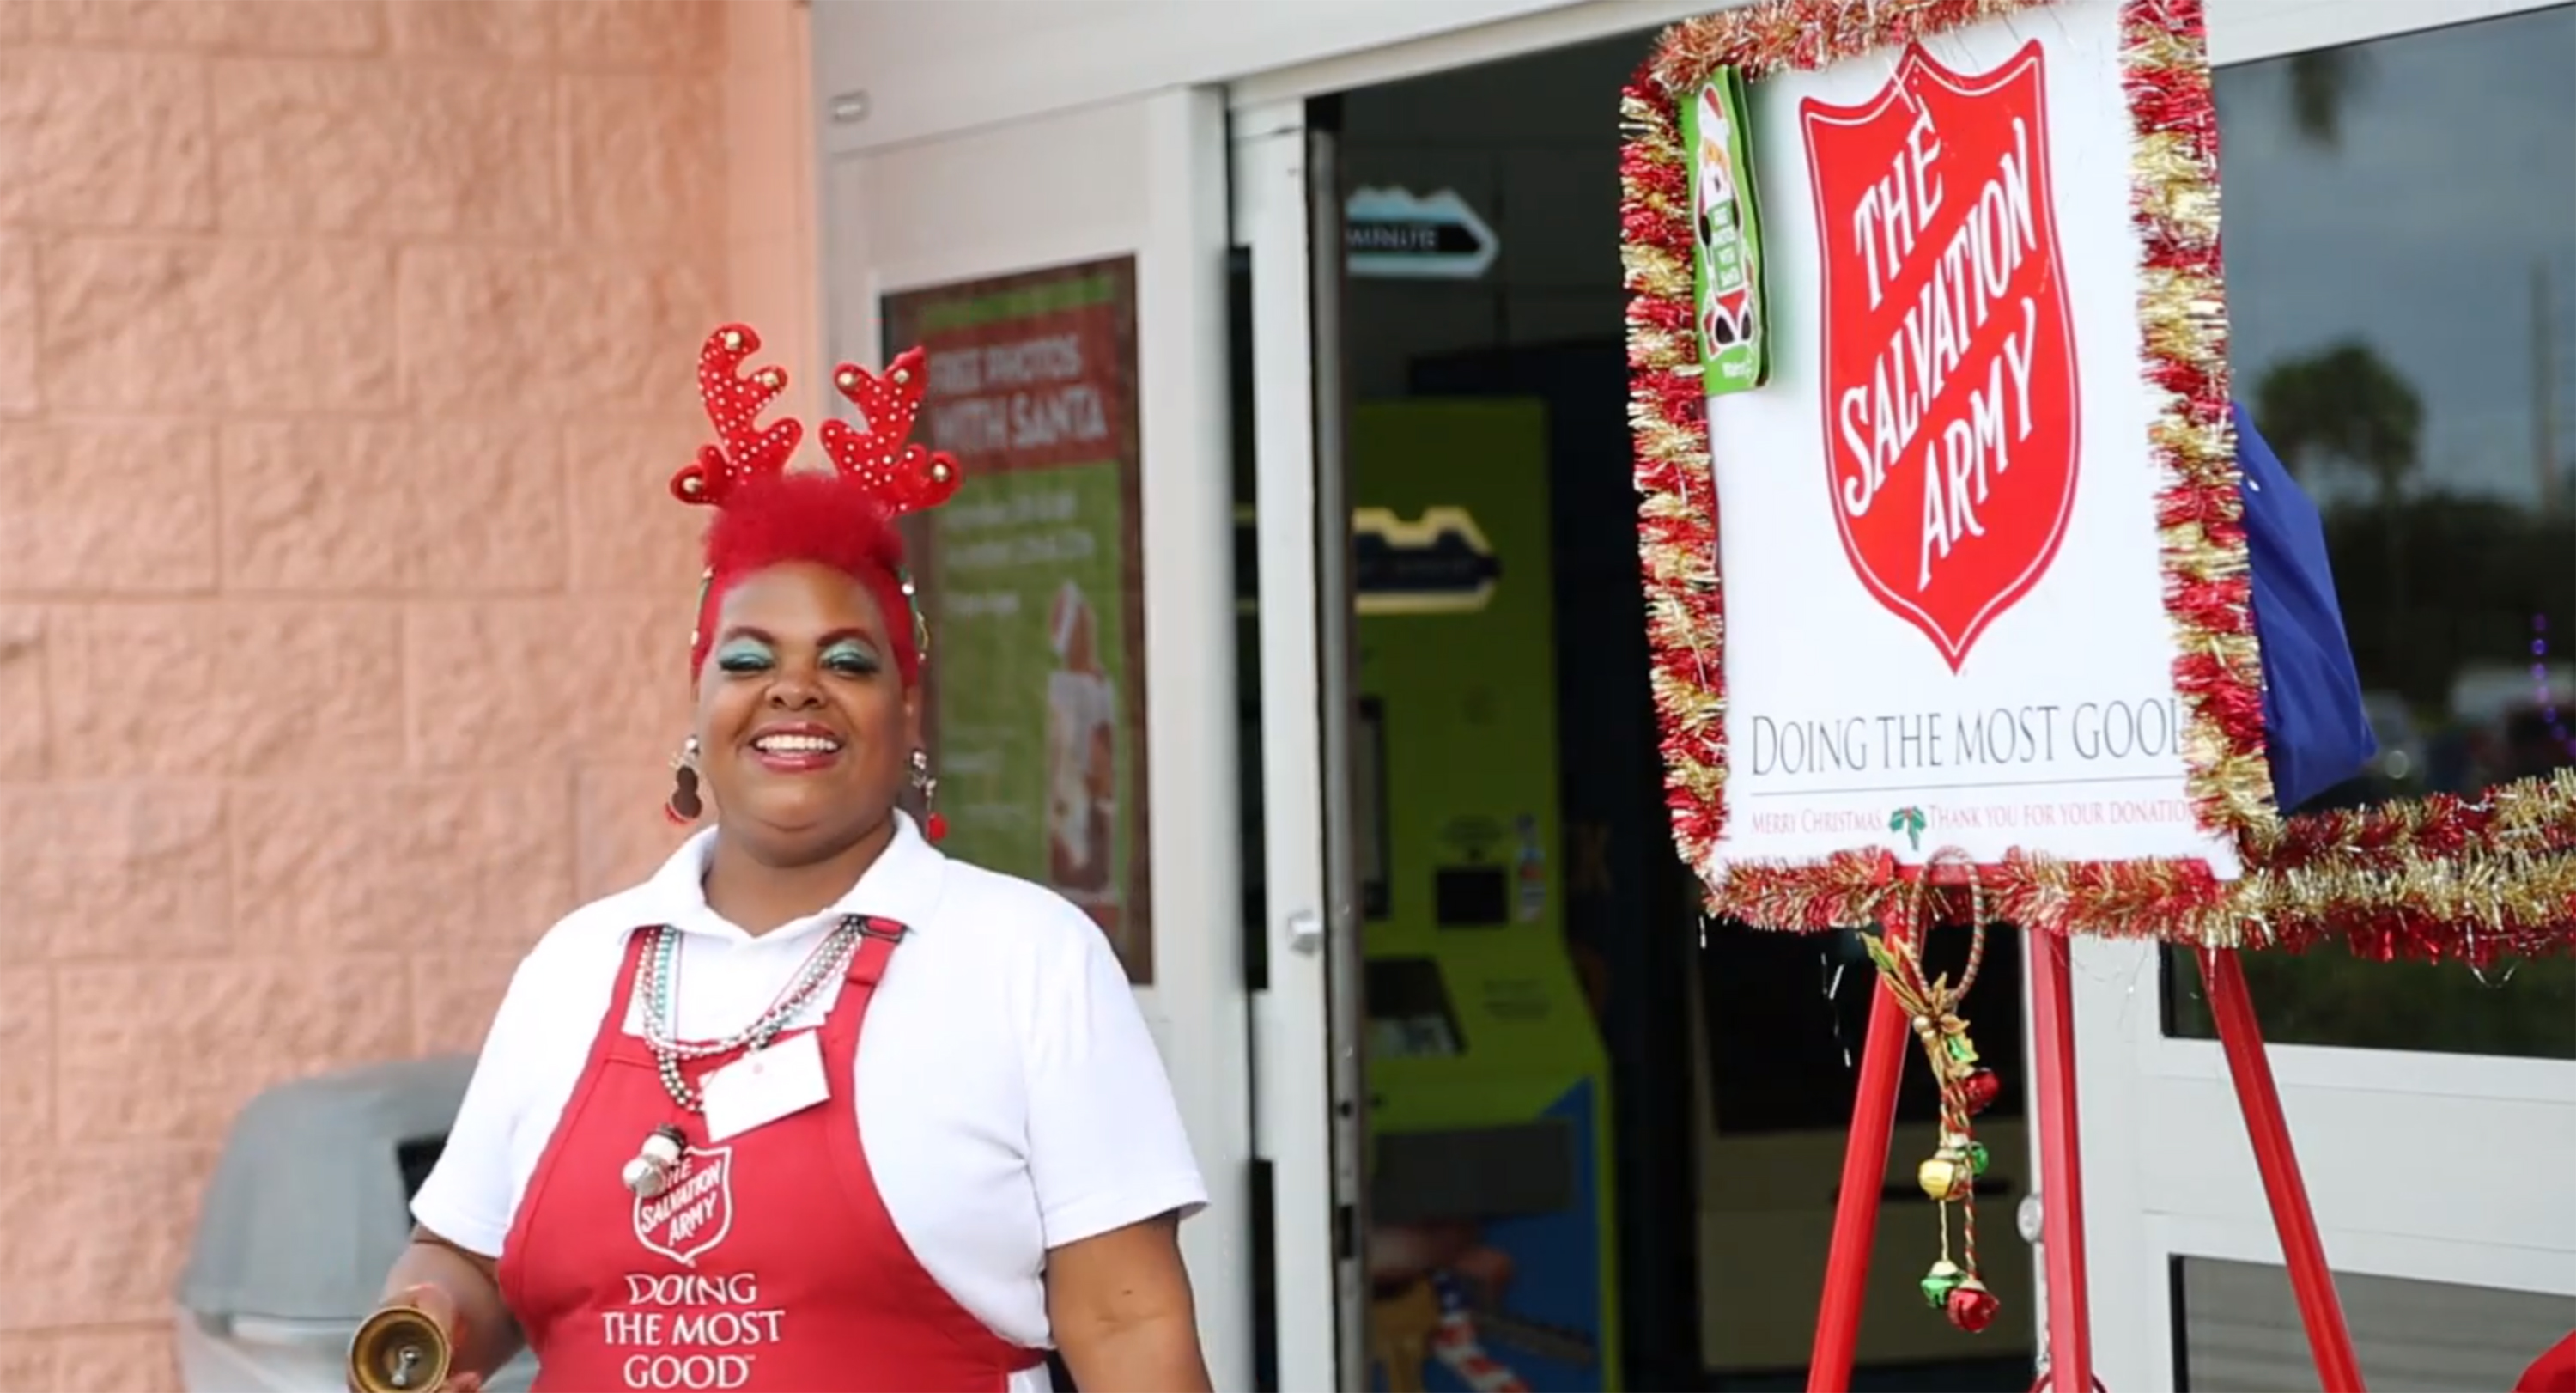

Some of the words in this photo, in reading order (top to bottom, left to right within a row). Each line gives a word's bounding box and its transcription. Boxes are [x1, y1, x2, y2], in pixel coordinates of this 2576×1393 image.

[1853, 112, 1943, 312] THE
[1840, 117, 2037, 517] SALVATION
[984, 335, 1081, 380] PHOTOS
[1012, 383, 1109, 447] SANTA
[1918, 297, 2036, 592] ARMY
[1752, 715, 1868, 776] DOING
[1876, 713, 1943, 769] THE
[1955, 706, 2059, 765] MOST
[1751, 811, 1796, 834] MERRY
[1801, 808, 1883, 834] CHRISTMAS
[1928, 804, 1981, 829] THANK
[1986, 806, 2019, 828] YOU
[2025, 804, 2057, 826] FOR
[2059, 802, 2105, 826] YOUR
[641, 1159, 722, 1234] SALVATION
[666, 1158, 693, 1188] HE
[667, 1189, 719, 1249] ARMY
[624, 1273, 757, 1305] DOING
[602, 1311, 664, 1346] THE
[671, 1310, 786, 1346] MOST
